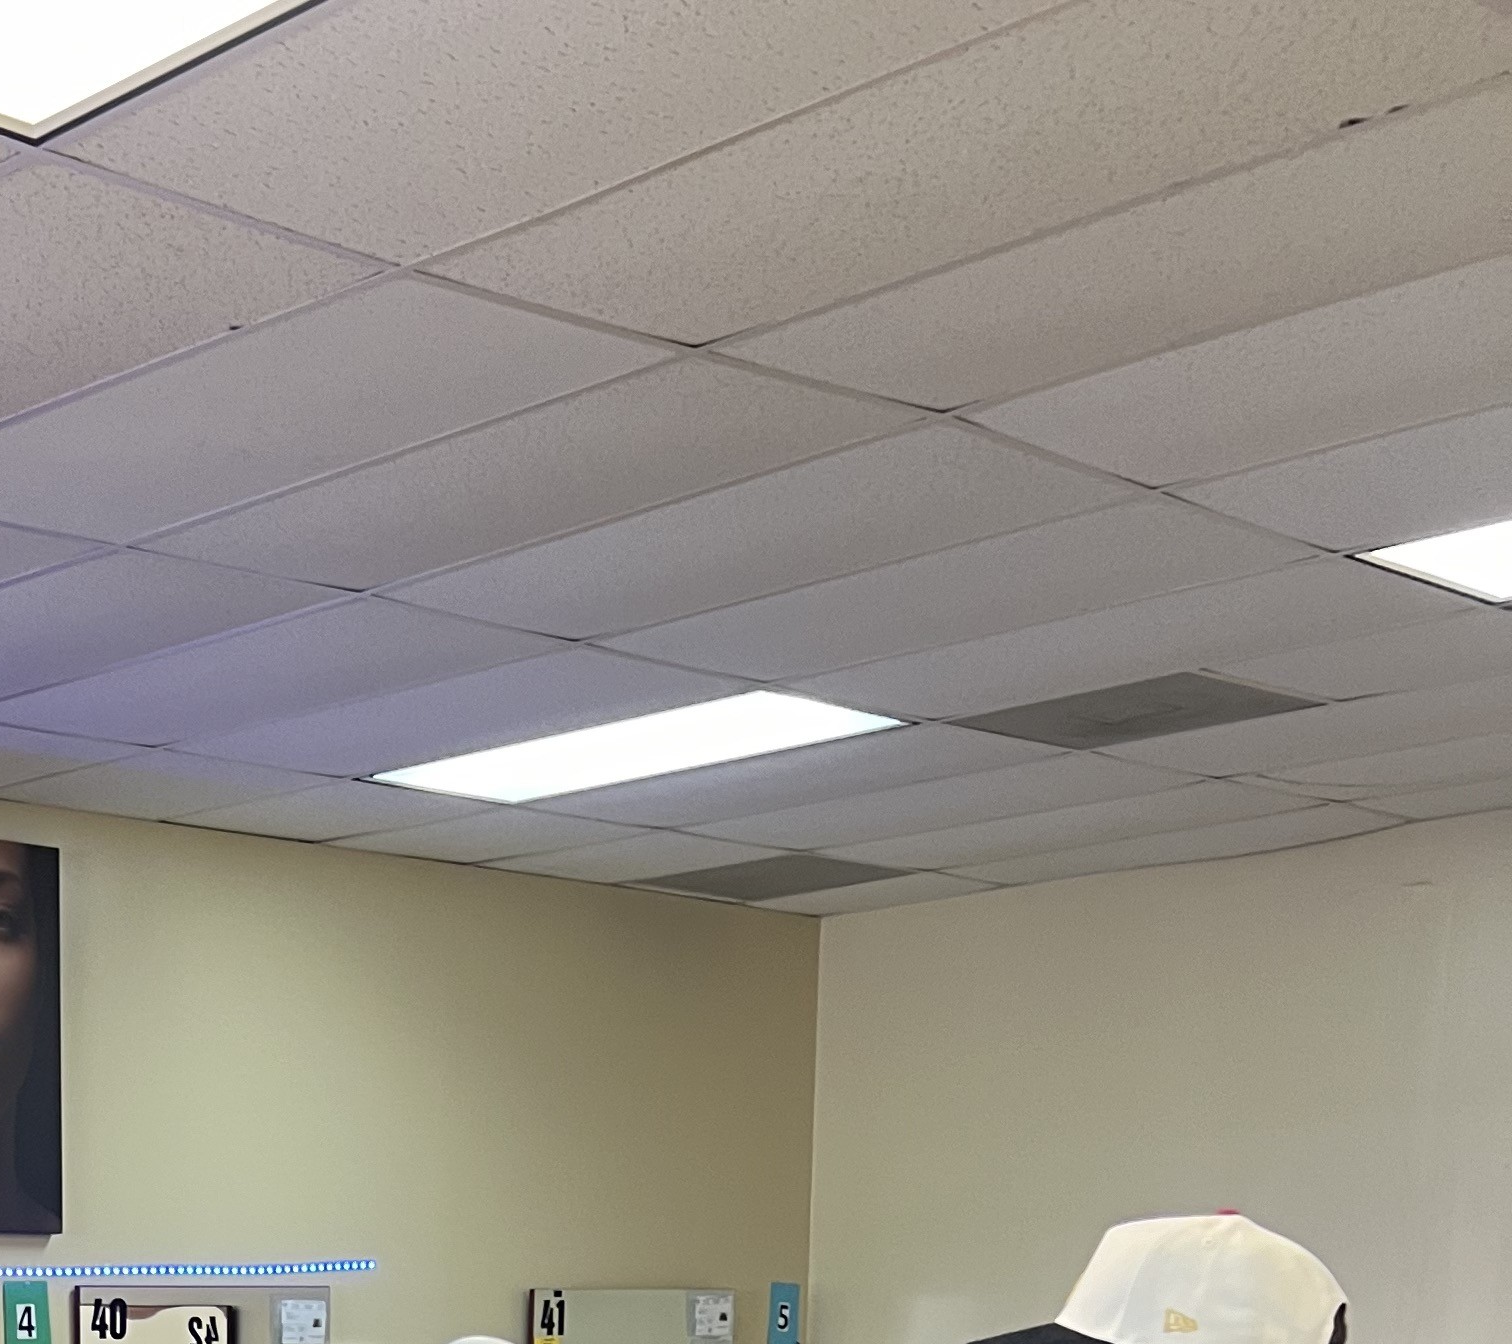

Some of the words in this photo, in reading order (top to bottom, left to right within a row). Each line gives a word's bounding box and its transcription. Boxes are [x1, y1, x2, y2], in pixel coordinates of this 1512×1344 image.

[18, 1311, 35, 1337] 4
[91, 1298, 128, 1340] 40
[541, 1300, 565, 1335] 41
[777, 1305, 789, 1329] 5
